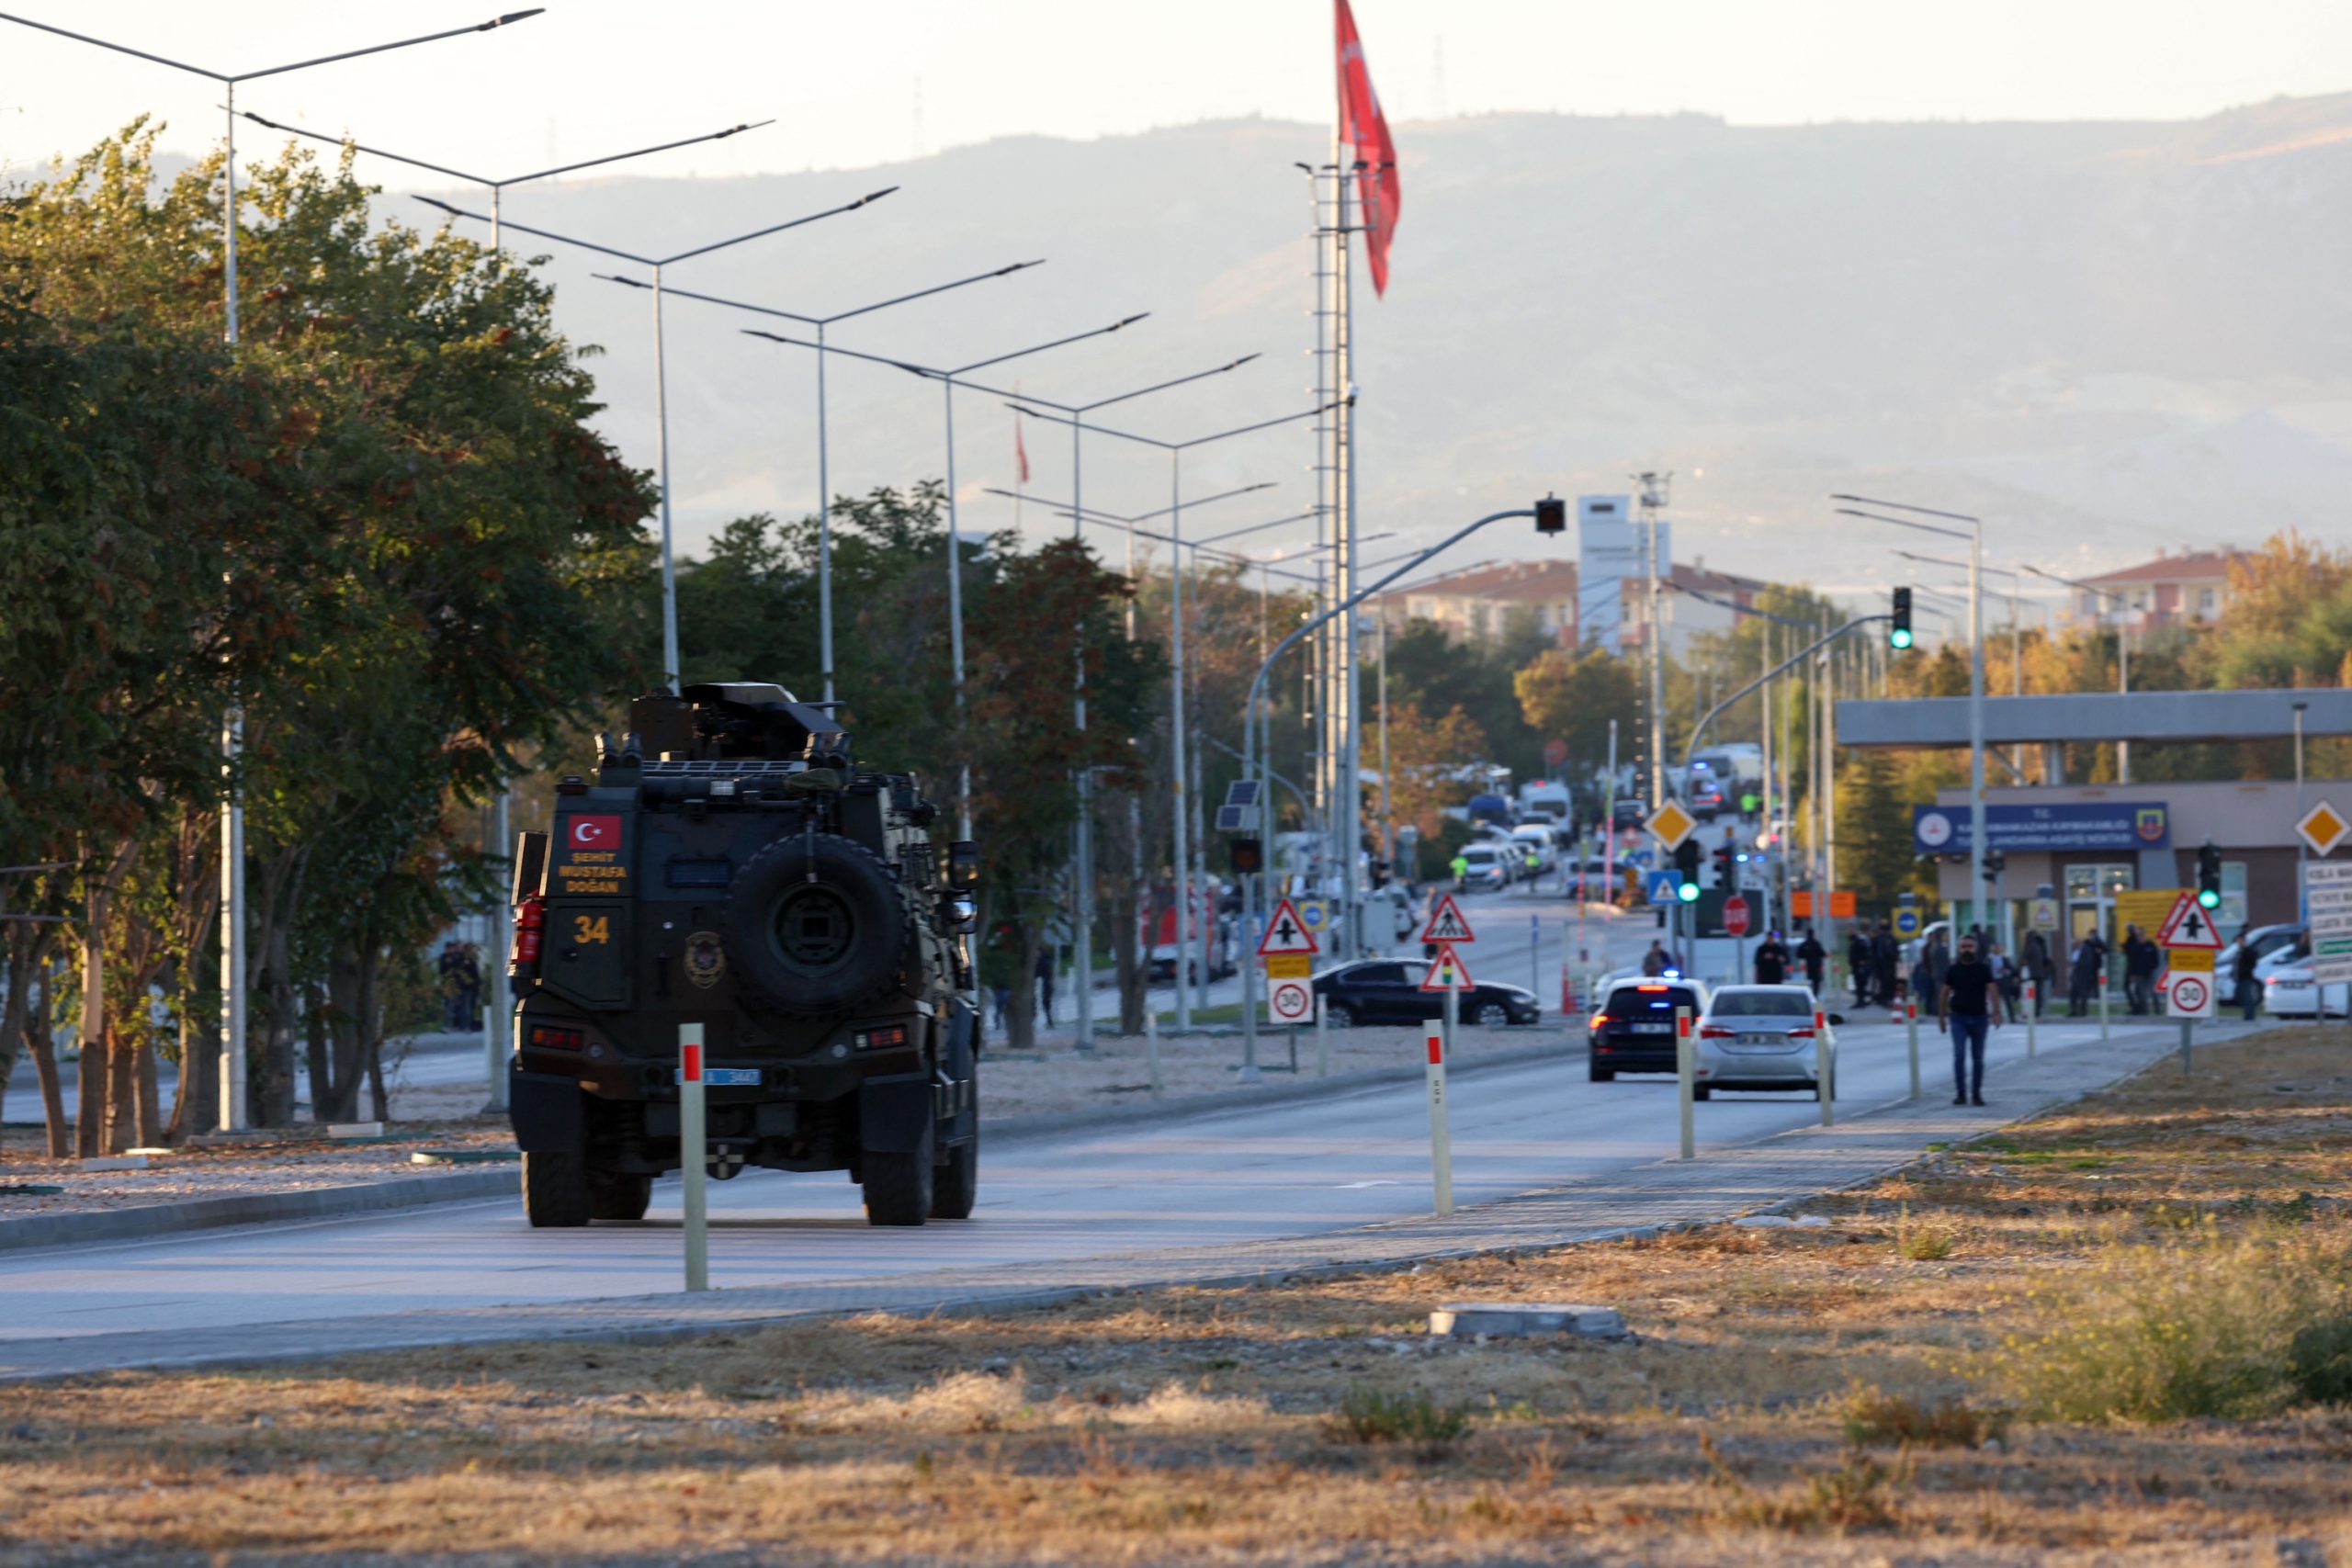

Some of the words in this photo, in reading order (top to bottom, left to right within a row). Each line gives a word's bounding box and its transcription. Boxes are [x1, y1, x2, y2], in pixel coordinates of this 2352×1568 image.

[559, 865, 628, 878] MUSTAFA
[566, 878, 619, 893] DOĞAN
[573, 915, 610, 944] 34
[1281, 992, 1300, 1008] 30
[2180, 987, 2201, 1002] 30
